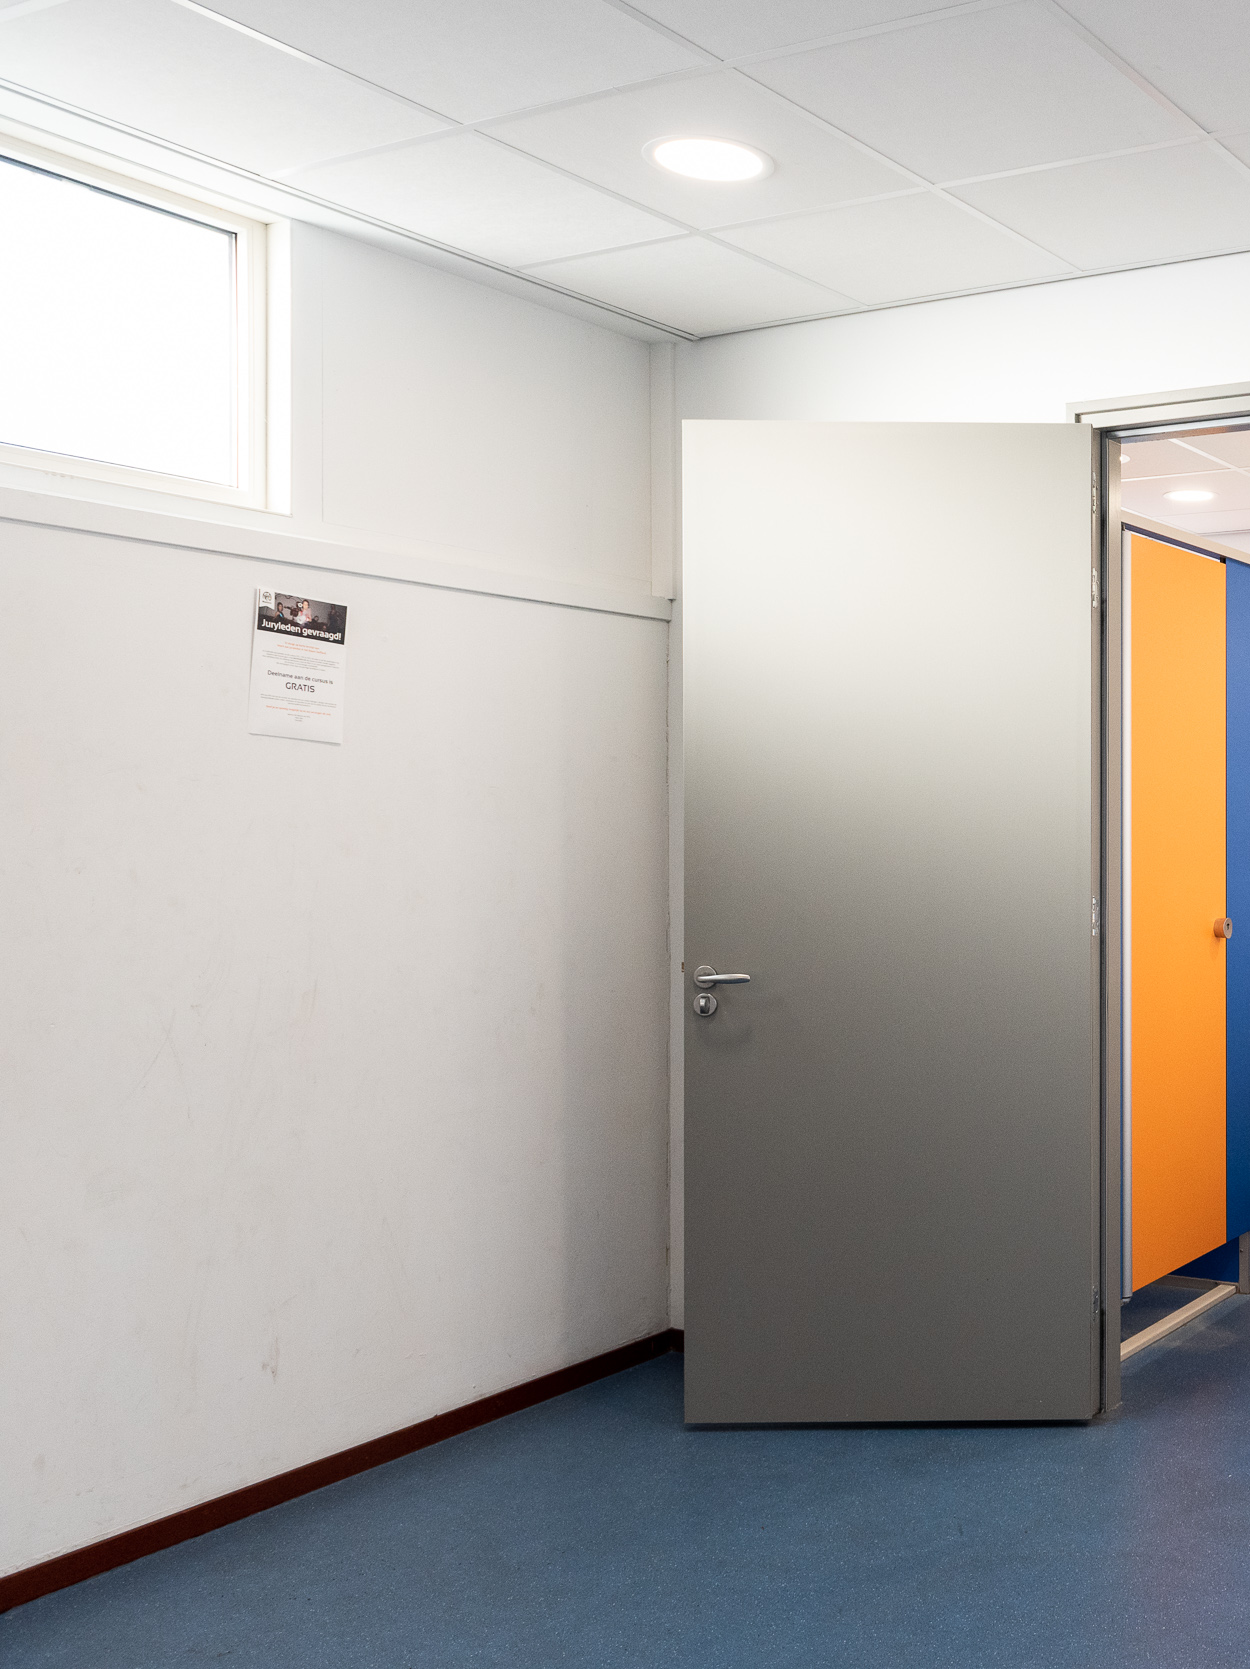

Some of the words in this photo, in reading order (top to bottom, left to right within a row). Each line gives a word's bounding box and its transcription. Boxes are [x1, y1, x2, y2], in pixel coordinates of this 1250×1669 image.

[262, 619, 301, 633] Juryleden
[302, 628, 342, 641] gevraagd!
[267, 670, 293, 679] Deelname
[285, 682, 315, 693] GRATIS
